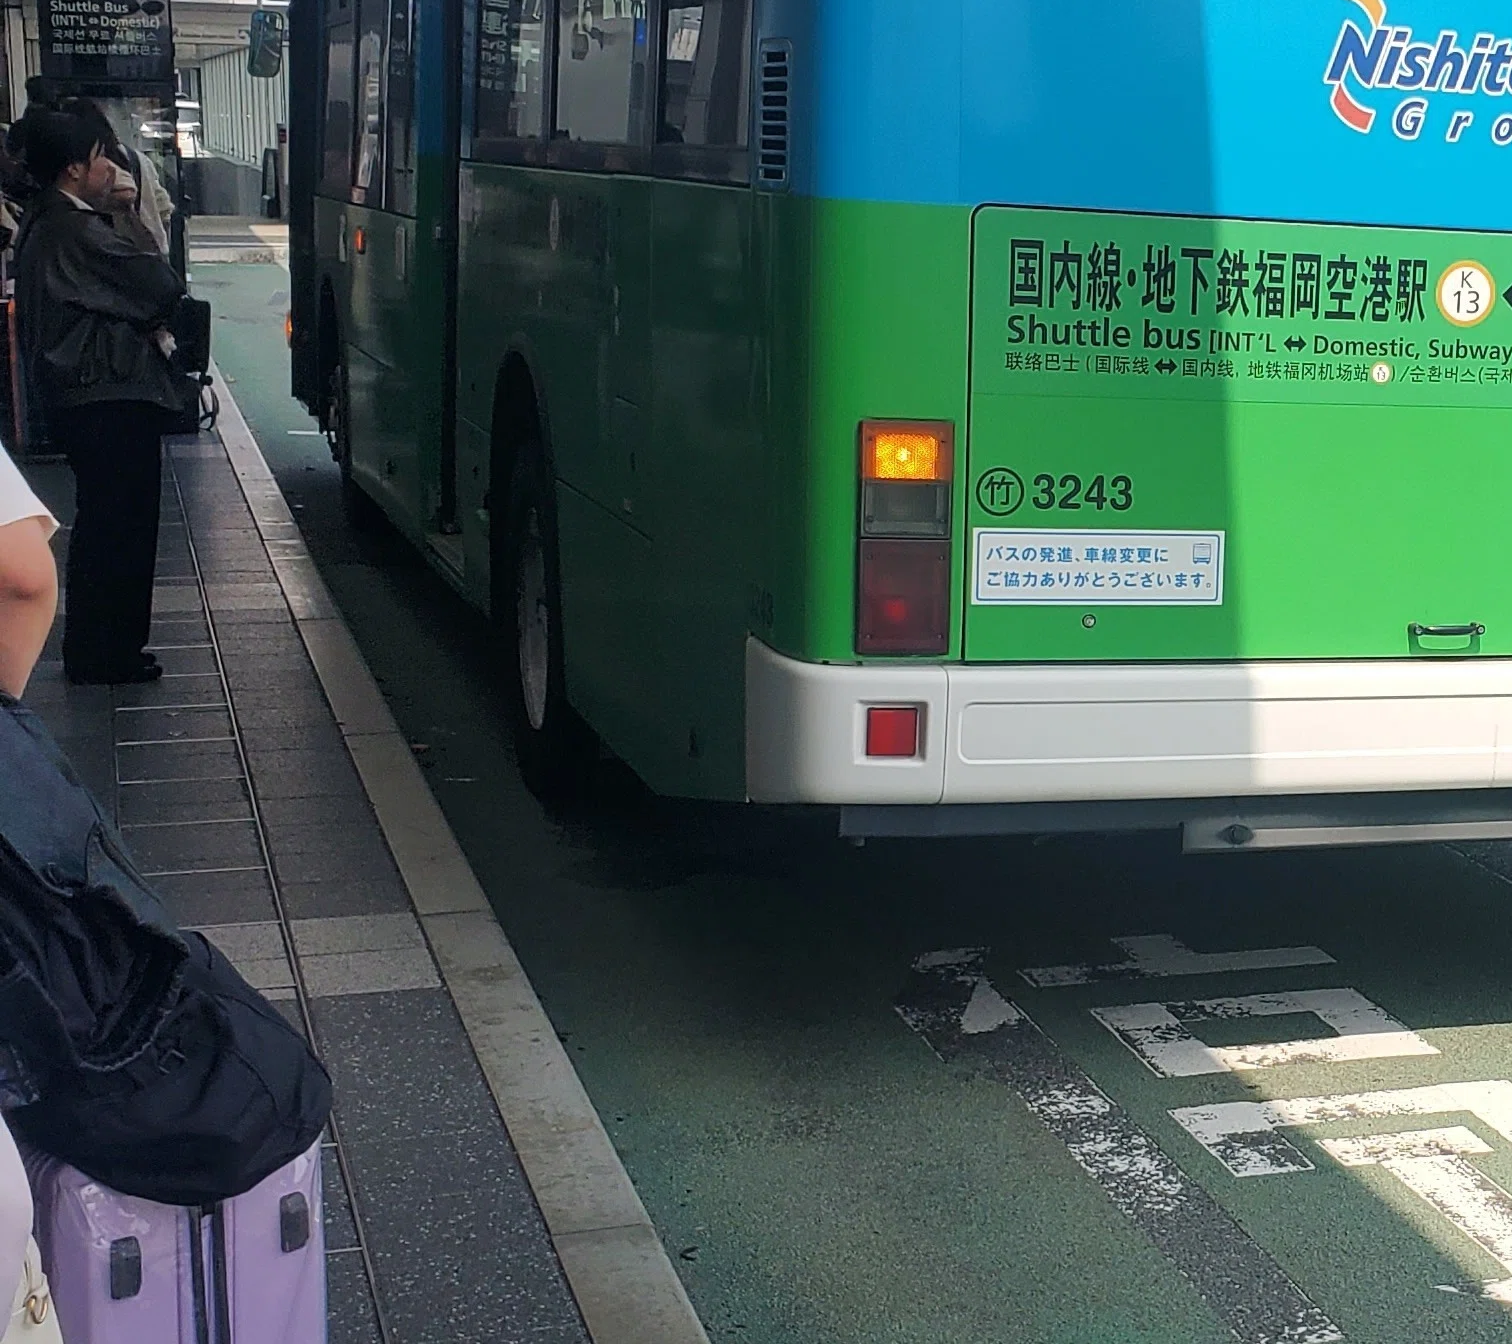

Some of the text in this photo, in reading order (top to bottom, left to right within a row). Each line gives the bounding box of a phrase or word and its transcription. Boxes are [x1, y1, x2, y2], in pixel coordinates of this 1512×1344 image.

[50, 0, 129, 13] Shuttle Bus
[1008, 238, 1429, 324] 国内線・地下鉄福岡空港駅
[1460, 270, 1474, 290] K
[1452, 290, 1481, 315] 13
[1006, 313, 1131, 349] Shuttle
[1143, 318, 1202, 350] bus
[1314, 335, 1421, 361] Domestic,
[984, 473, 1133, 511] 竹 3243
[986, 546, 1169, 564] バスの発進、車線変更に
[986, 570, 1212, 589] ご協力ありがとうございます。
